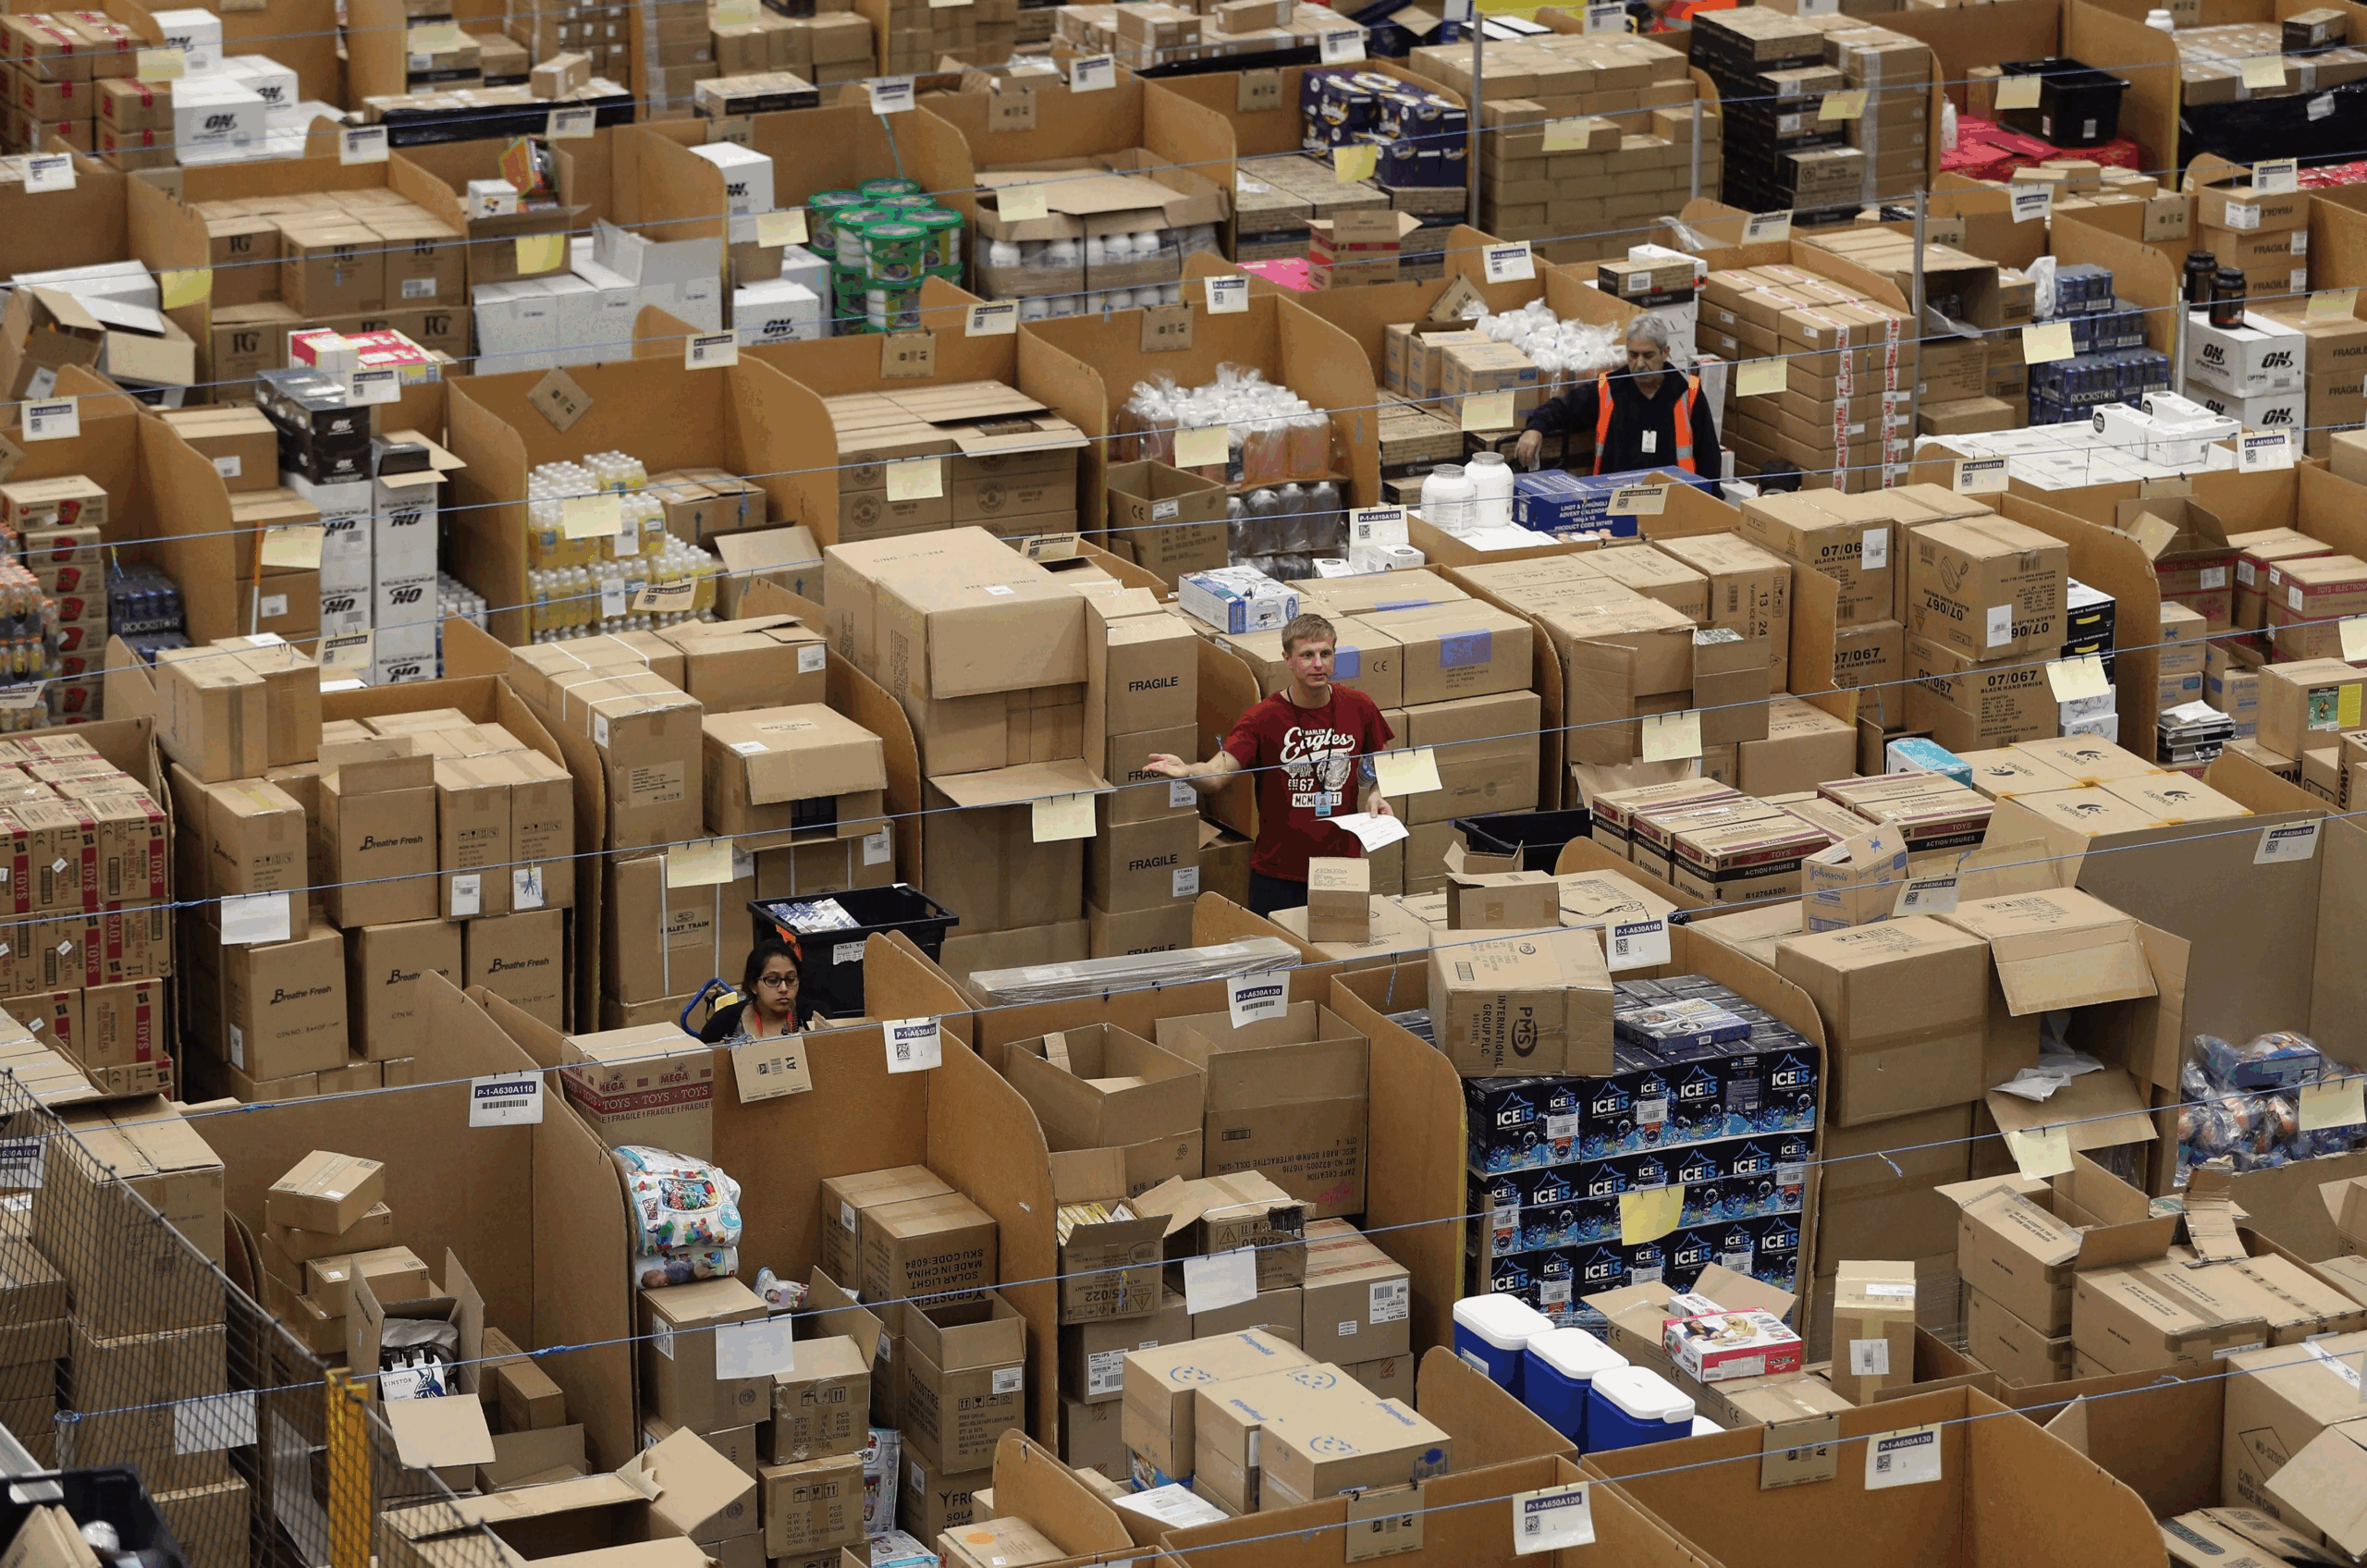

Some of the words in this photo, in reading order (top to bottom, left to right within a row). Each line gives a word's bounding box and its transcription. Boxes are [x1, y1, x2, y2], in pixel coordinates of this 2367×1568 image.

[2253, 243, 2289, 255] FRAGILE
[2253, 279, 2289, 291] FRAGILE
[2202, 344, 2225, 365] ON
[2261, 351, 2293, 368] ON
[2262, 408, 2293, 425] ON
[1814, 557, 1835, 565] BLACK
[389, 584, 423, 605] ON
[1760, 592, 1768, 607] 13
[1926, 596, 1964, 621] 07/067
[2034, 615, 2056, 624] BLACK
[1865, 658, 1887, 667] WHISK
[1129, 676, 1179, 692] FRAGILE
[1987, 670, 2038, 687] 07/067
[1981, 686, 2002, 694] BLACK
[2003, 683, 2021, 692] HAND
[2022, 680, 2043, 689] WHISK
[1299, 778, 1314, 791] 67
[1953, 821, 1971, 830] TOYS
[360, 836, 398, 851] Breathe
[400, 836, 423, 845] Fresh
[1926, 837, 1948, 848] ACTION
[1948, 835, 1975, 845] FIGURES
[1771, 849, 1791, 858] TOYS
[152, 853, 164, 885] TOYS
[1129, 853, 1178, 871] FRAGILE
[1677, 858, 1691, 871] ACTION
[1691, 866, 1710, 879] FIGURES
[1745, 865, 1767, 876] ACTION
[1768, 862, 1795, 873] FIGURES
[83, 861, 95, 892] TOYS
[16, 869, 29, 900] TOYS
[689, 921, 709, 929] TRAIN
[1616, 923, 1661, 935] P-1-A630A140
[88, 941, 99, 974] TOYS
[487, 959, 525, 974] Breathe
[527, 958, 550, 967] Fresh
[386, 969, 422, 986] Breath
[270, 988, 308, 1006] Breathe
[310, 986, 332, 996] Fresh
[1237, 987, 1281, 1001] P-1-A630A130
[1482, 1003, 1491, 1037] GROUP
[1517, 1006, 1534, 1046] PMS
[138, 1019, 150, 1051] TOYS
[1494, 995, 1506, 1068] INTERNATIONAL
[786, 1056, 797, 1070] A1
[660, 1072, 689, 1084] MEGA
[1772, 1071, 1809, 1085] ICEIS
[477, 1084, 533, 1097] P-1-A630A110
[1641, 1083, 1665, 1093] ICEIS
[1680, 1081, 1717, 1097] ICEIS
[603, 1098, 631, 1109] TOYS
[643, 1093, 669, 1104] TOYS
[681, 1086, 708, 1098] TOYS
[1551, 1096, 1576, 1108] ICEIS
[1593, 1096, 1629, 1114] ICEIS
[612, 1111, 640, 1122] FRAGILE
[647, 1108, 675, 1118] FRAGILE
[681, 1102, 708, 1112] FRAGILE
[1497, 1108, 1534, 1126] ICEIS
[1321, 1149, 1339, 1158] BABY
[1781, 1144, 1806, 1155] ICEIS
[1253, 1155, 1294, 1167] INTERACTIVE
[1734, 1158, 1771, 1174] ICEIS
[1306, 1170, 1337, 1181] CREATION
[1340, 1168, 1355, 1176] ZAPF
[1638, 1166, 1663, 1177] ICEIS
[1679, 1165, 1716, 1182] ICEIS
[1491, 1187, 1516, 1198] ICEIS
[1588, 1178, 1625, 1196] ICEIS
[1533, 1186, 1570, 1204] ICEIS
[1725, 1235, 1750, 1245] ICEIS
[1761, 1233, 1797, 1249] ICEIS
[905, 1253, 961, 1269] CODE:6084
[963, 1248, 984, 1260] SKU
[1636, 1249, 1661, 1261] ICEIS
[1674, 1248, 1711, 1265] ICEIS
[906, 1267, 938, 1279] CHINA
[940, 1265, 950, 1274] IN
[953, 1259, 982, 1272] MADE
[1544, 1262, 1569, 1273] ICEIS
[1585, 1262, 1622, 1280] ICEIS
[910, 1277, 941, 1290] LIGHT
[943, 1270, 978, 1284] SOLAR
[1491, 1274, 1527, 1292] ICEIS
[1880, 1434, 1932, 1451] P-1-A650A130
[1527, 1495, 1580, 1512] P-1-A650A120
